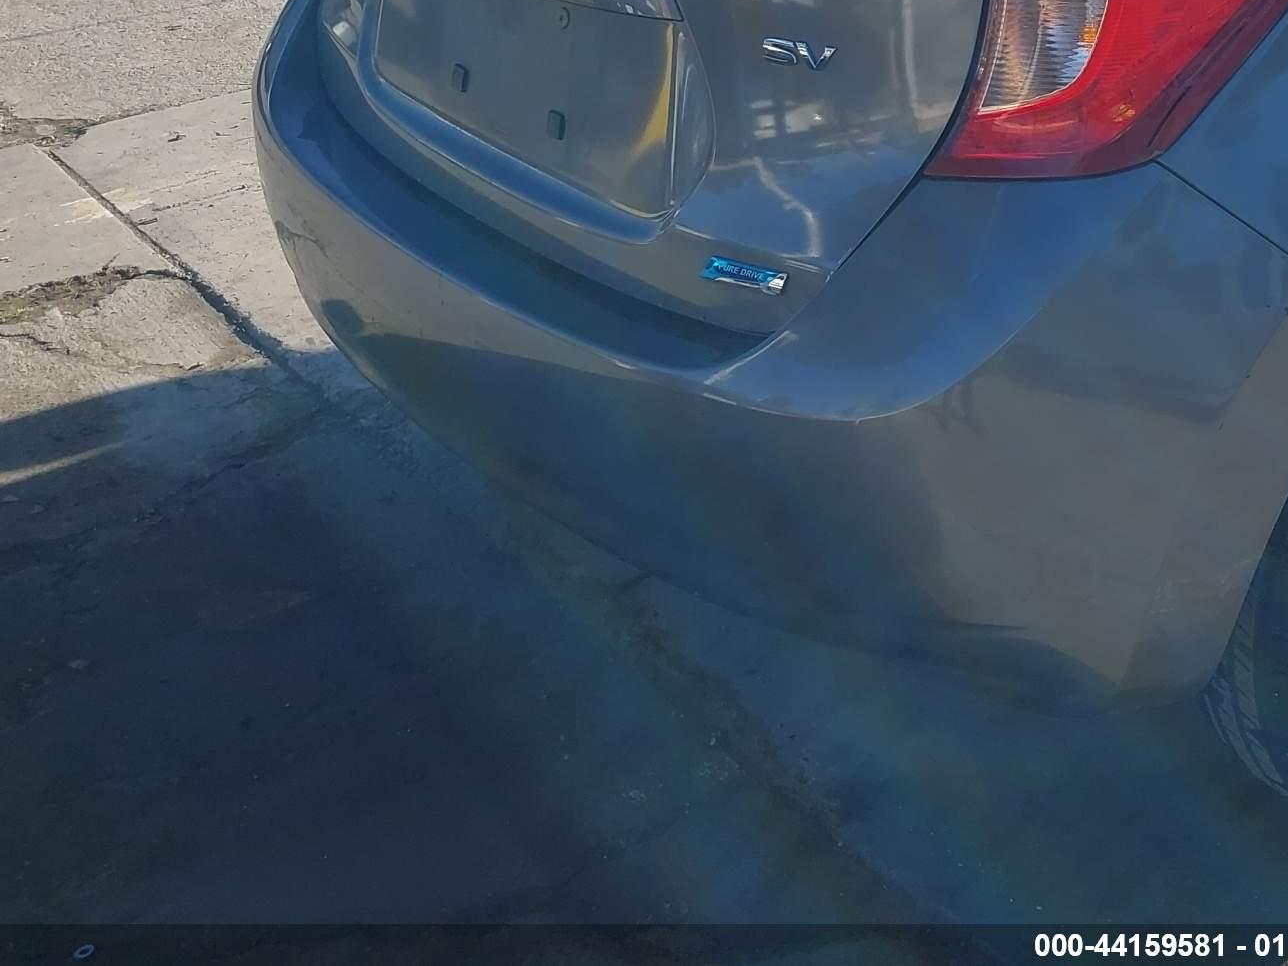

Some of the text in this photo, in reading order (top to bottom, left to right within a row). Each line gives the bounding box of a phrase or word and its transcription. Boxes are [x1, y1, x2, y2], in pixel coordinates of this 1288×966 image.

[762, 37, 837, 69] SV
[718, 264, 766, 282] PURE DRIVE
